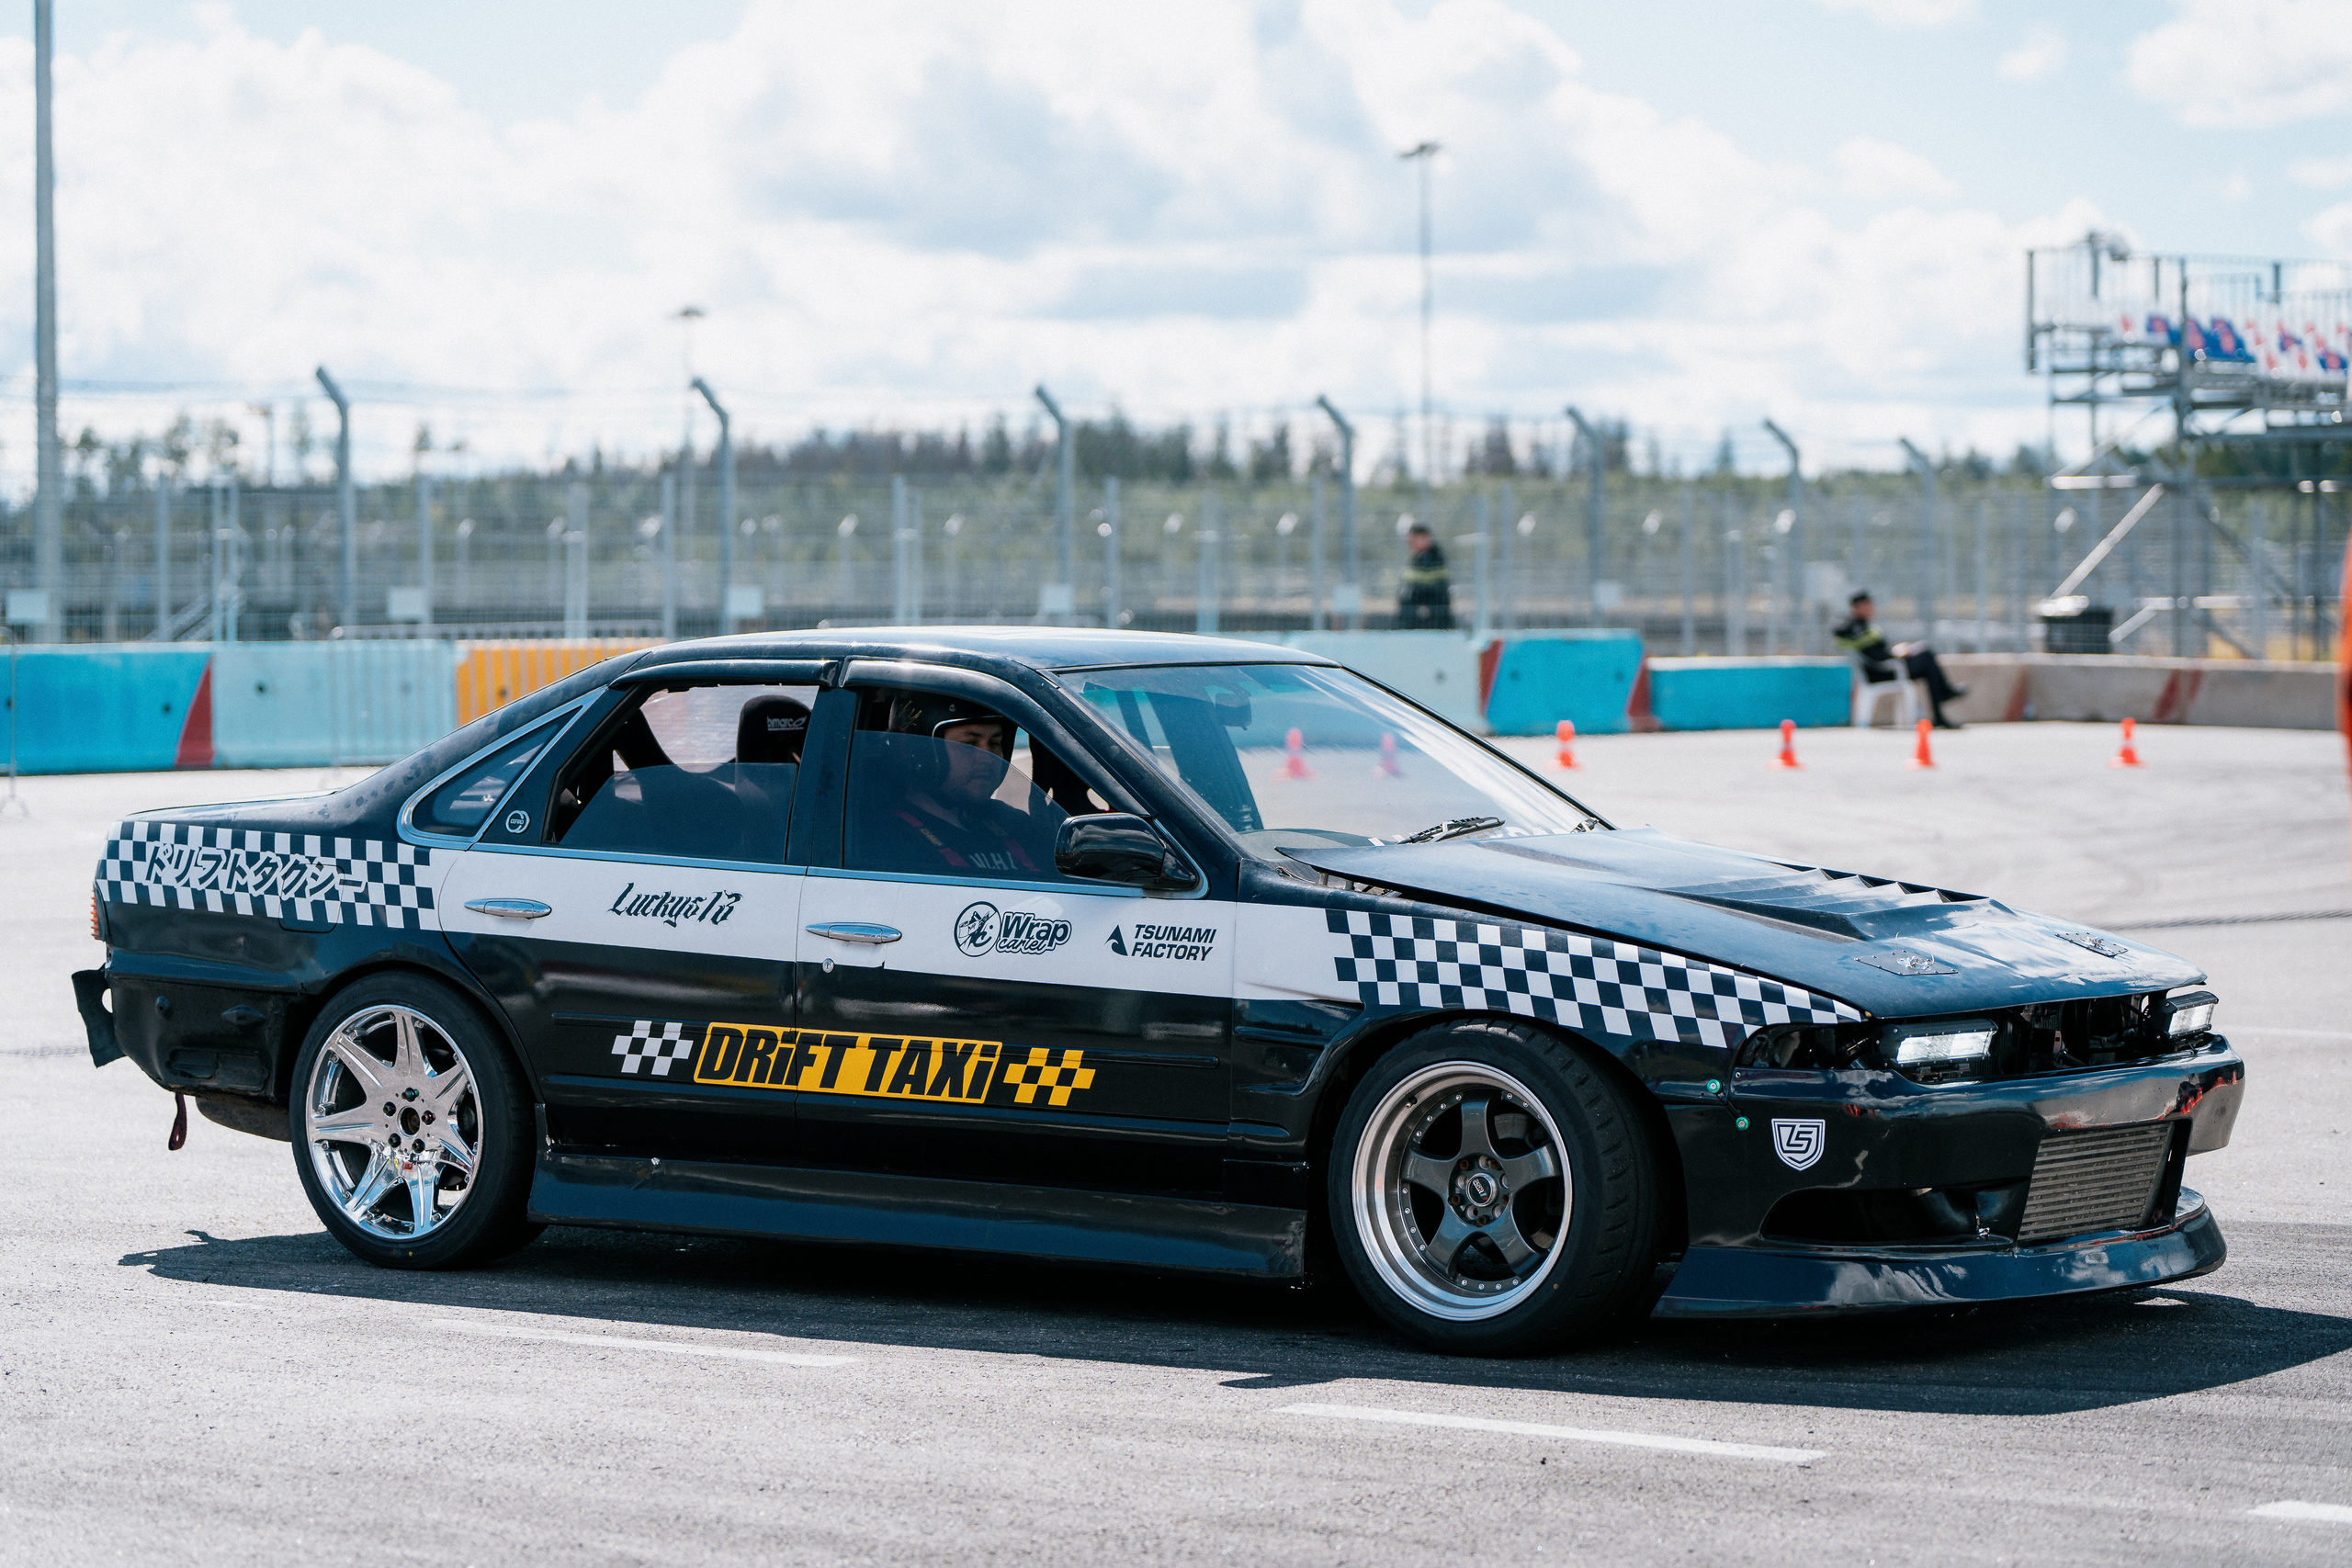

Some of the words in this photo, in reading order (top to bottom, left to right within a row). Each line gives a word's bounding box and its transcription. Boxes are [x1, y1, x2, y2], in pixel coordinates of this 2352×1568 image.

[143, 843, 366, 900] ドリフトタクシー
[1001, 912, 1069, 947] Wrap
[1134, 923, 1217, 944] TSUNAMI
[1131, 942, 1214, 962] FACTORY
